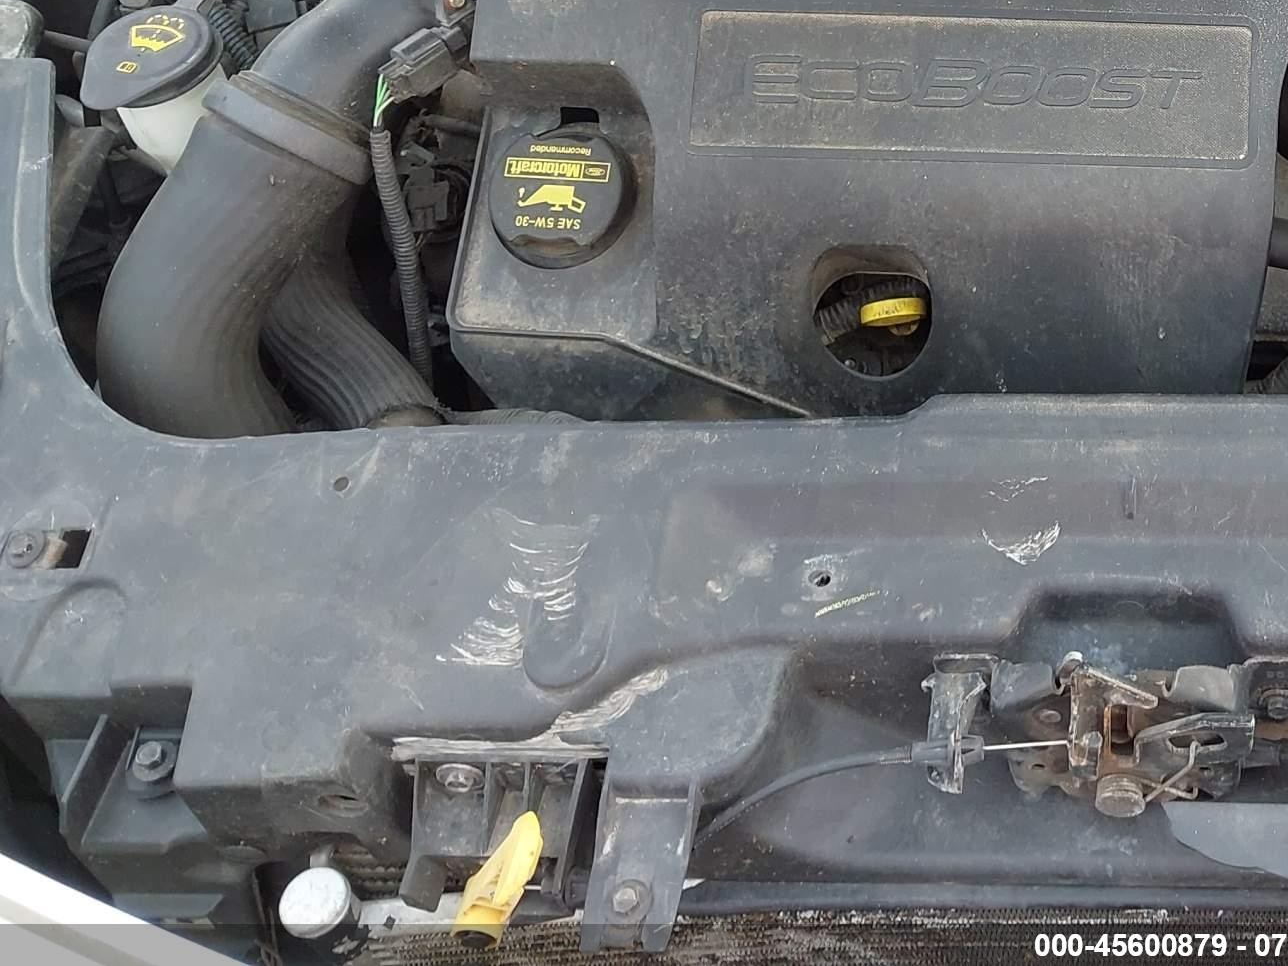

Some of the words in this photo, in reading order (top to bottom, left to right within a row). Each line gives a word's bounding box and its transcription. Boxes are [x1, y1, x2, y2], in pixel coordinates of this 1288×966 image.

[530, 145, 591, 155] Recommended
[510, 161, 580, 177] Motorcraft
[516, 216, 554, 228] 5W-30
[558, 218, 580, 229] SAE
